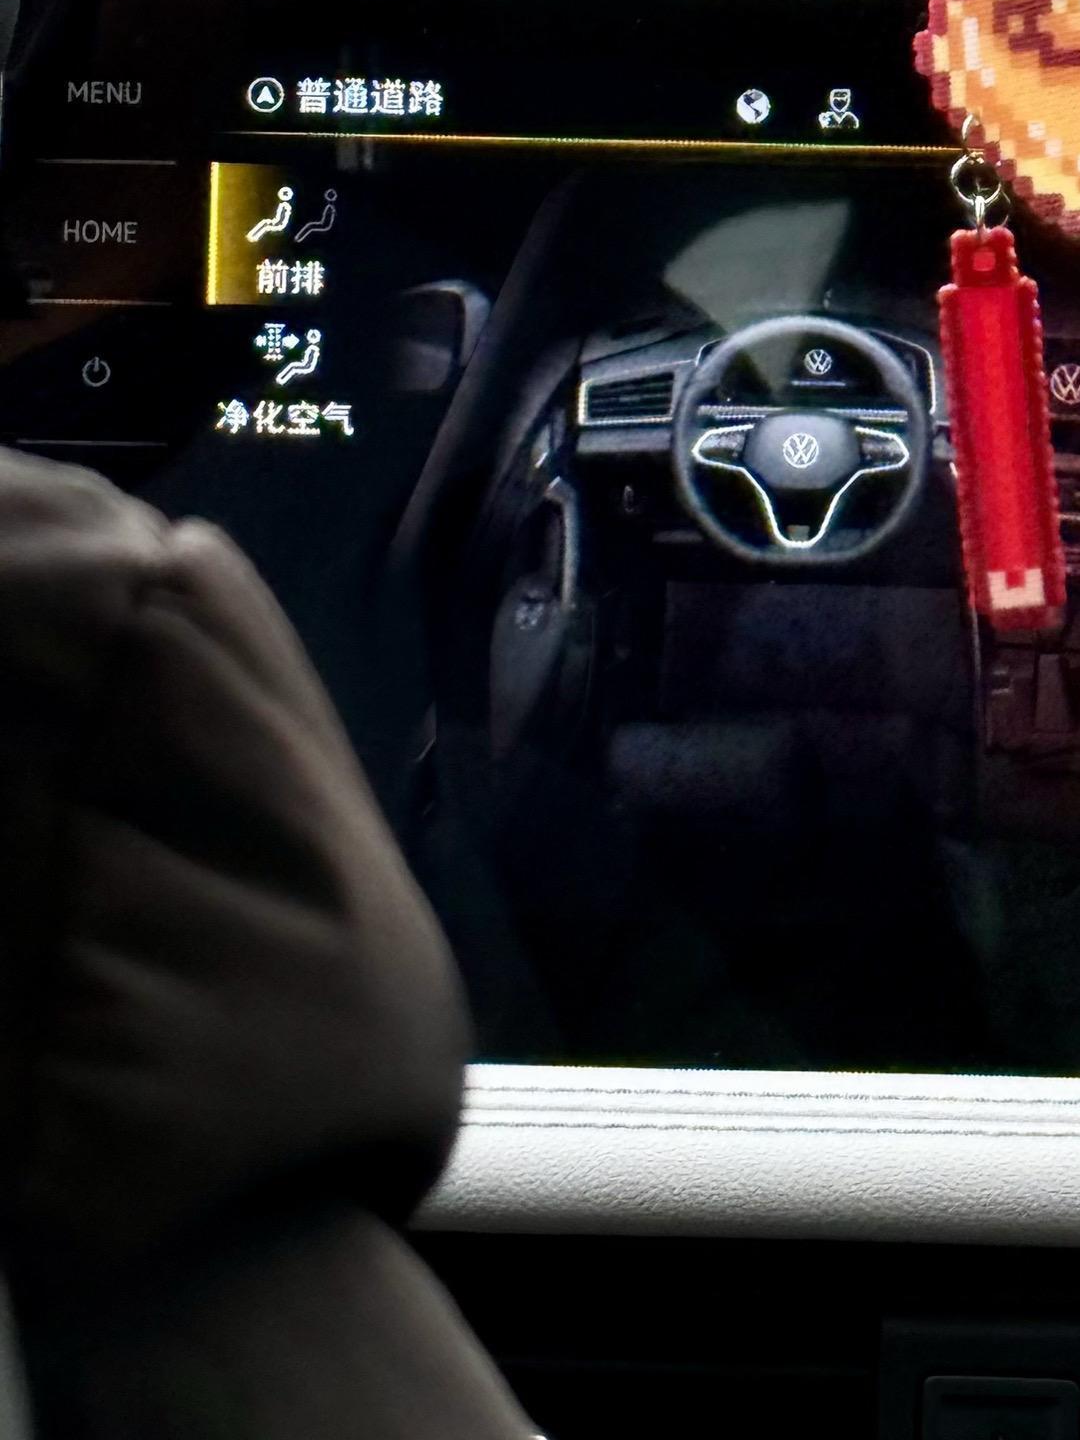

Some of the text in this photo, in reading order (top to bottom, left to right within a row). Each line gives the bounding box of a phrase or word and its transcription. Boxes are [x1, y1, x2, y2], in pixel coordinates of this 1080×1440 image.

[67, 81, 142, 105] MENU
[295, 77, 444, 117] 普通道路
[63, 219, 138, 244] HOME
[256, 258, 325, 295] 前排
[215, 399, 355, 437] 净化空气
